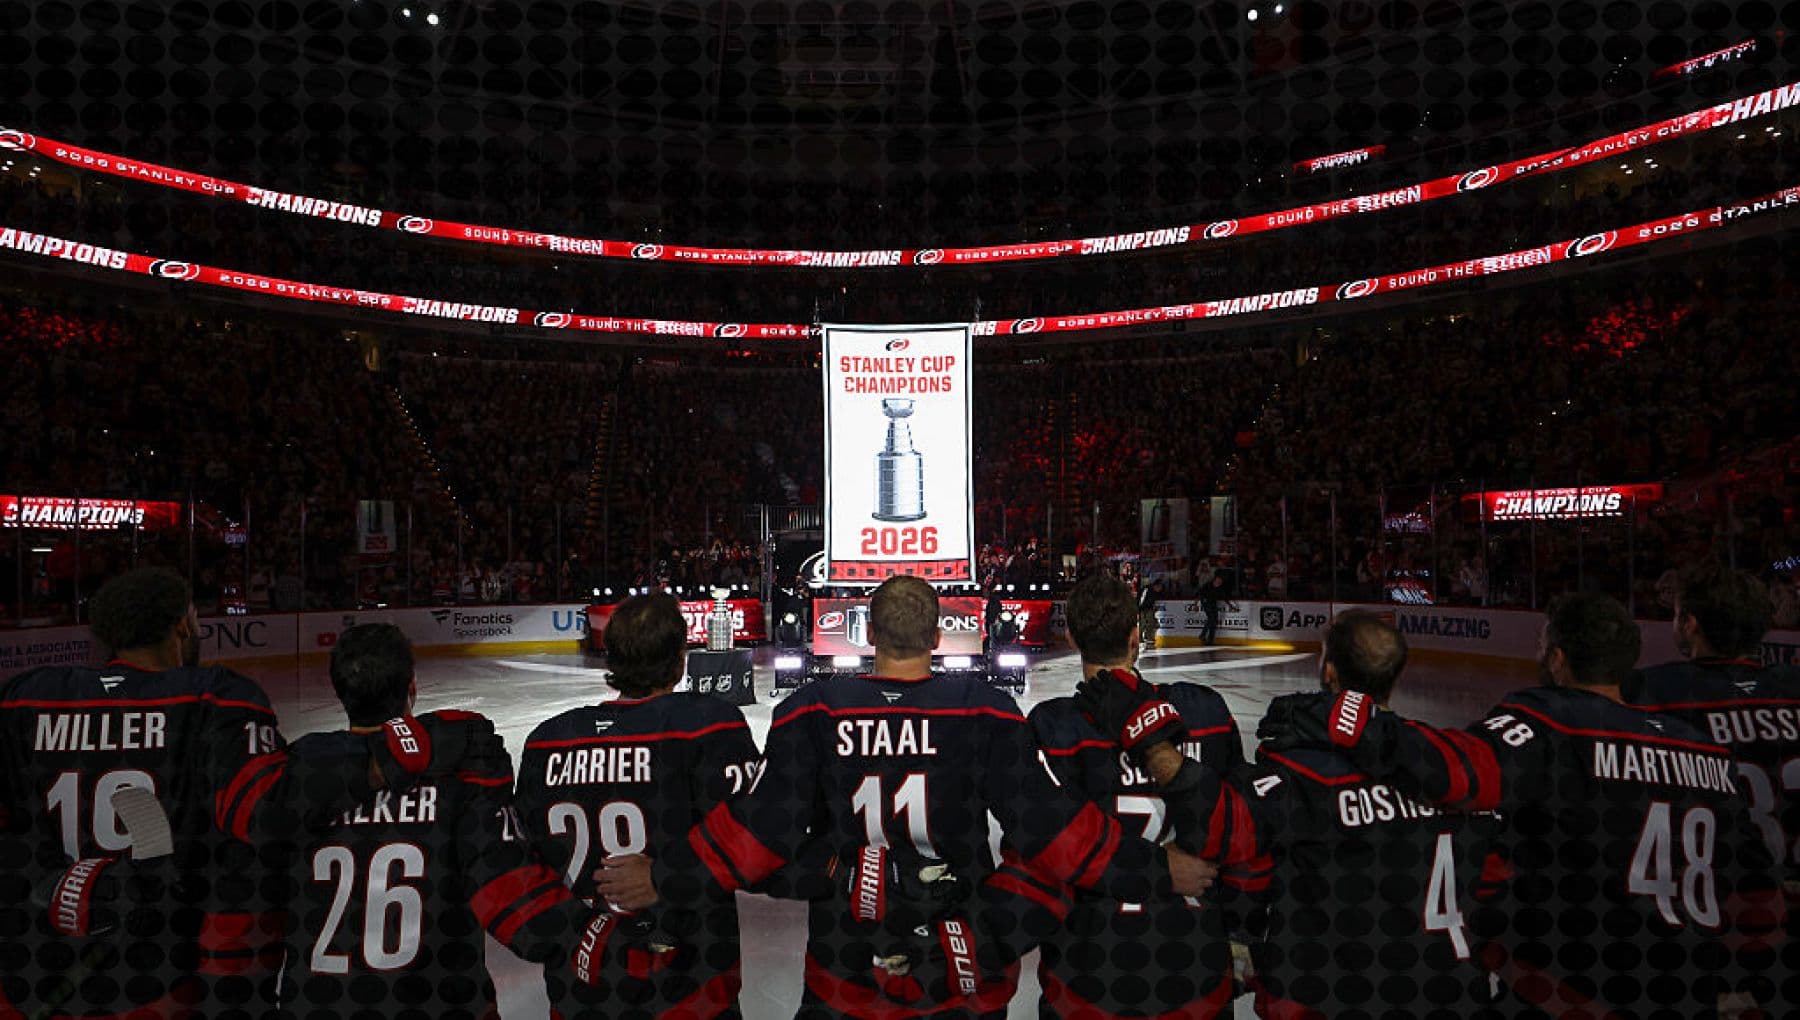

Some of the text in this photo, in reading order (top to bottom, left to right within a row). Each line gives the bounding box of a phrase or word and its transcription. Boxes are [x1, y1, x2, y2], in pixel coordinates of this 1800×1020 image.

[1570, 132, 1650, 161] STANLEY
[115, 162, 195, 187] STANLEY
[202, 181, 235, 194] CUP
[246, 187, 382, 227] CHAMPIONS
[1267, 209, 1314, 226] SOUND
[1321, 202, 1350, 217] THE
[464, 227, 510, 241] SOUND
[517, 234, 543, 246] THE
[1080, 226, 1190, 255] CHAMPIONS
[799, 250, 901, 267] CHAMPIONS
[1388, 271, 1437, 288] SOUND
[1446, 264, 1474, 278] THE
[277, 283, 352, 301] STANLEY
[1205, 287, 1319, 316] CHAMPIONS
[402, 296, 519, 323] CHAMPIONS
[840, 356, 955, 374] STANLEY CUP
[844, 376, 952, 394] CHAMPIONS
[3, 503, 145, 524] CHAMPIONS
[1494, 493, 1622, 515] CHAMPIONS
[860, 527, 938, 555] 2026
[454, 611, 513, 625] Fanatics
[1400, 616, 1490, 639] AMAZING
[34, 712, 167, 751] MILLER
[836, 719, 938, 756] STAAL
[1483, 714, 1534, 747] 48
[1706, 708, 1800, 744] BUSS
[546, 747, 651, 786] CARRIER
[1594, 742, 1737, 794] MARTINOOK
[851, 773, 942, 860] 11
[1628, 801, 1721, 928] 48
[310, 842, 426, 974] 26
[1425, 833, 1470, 959] 4
